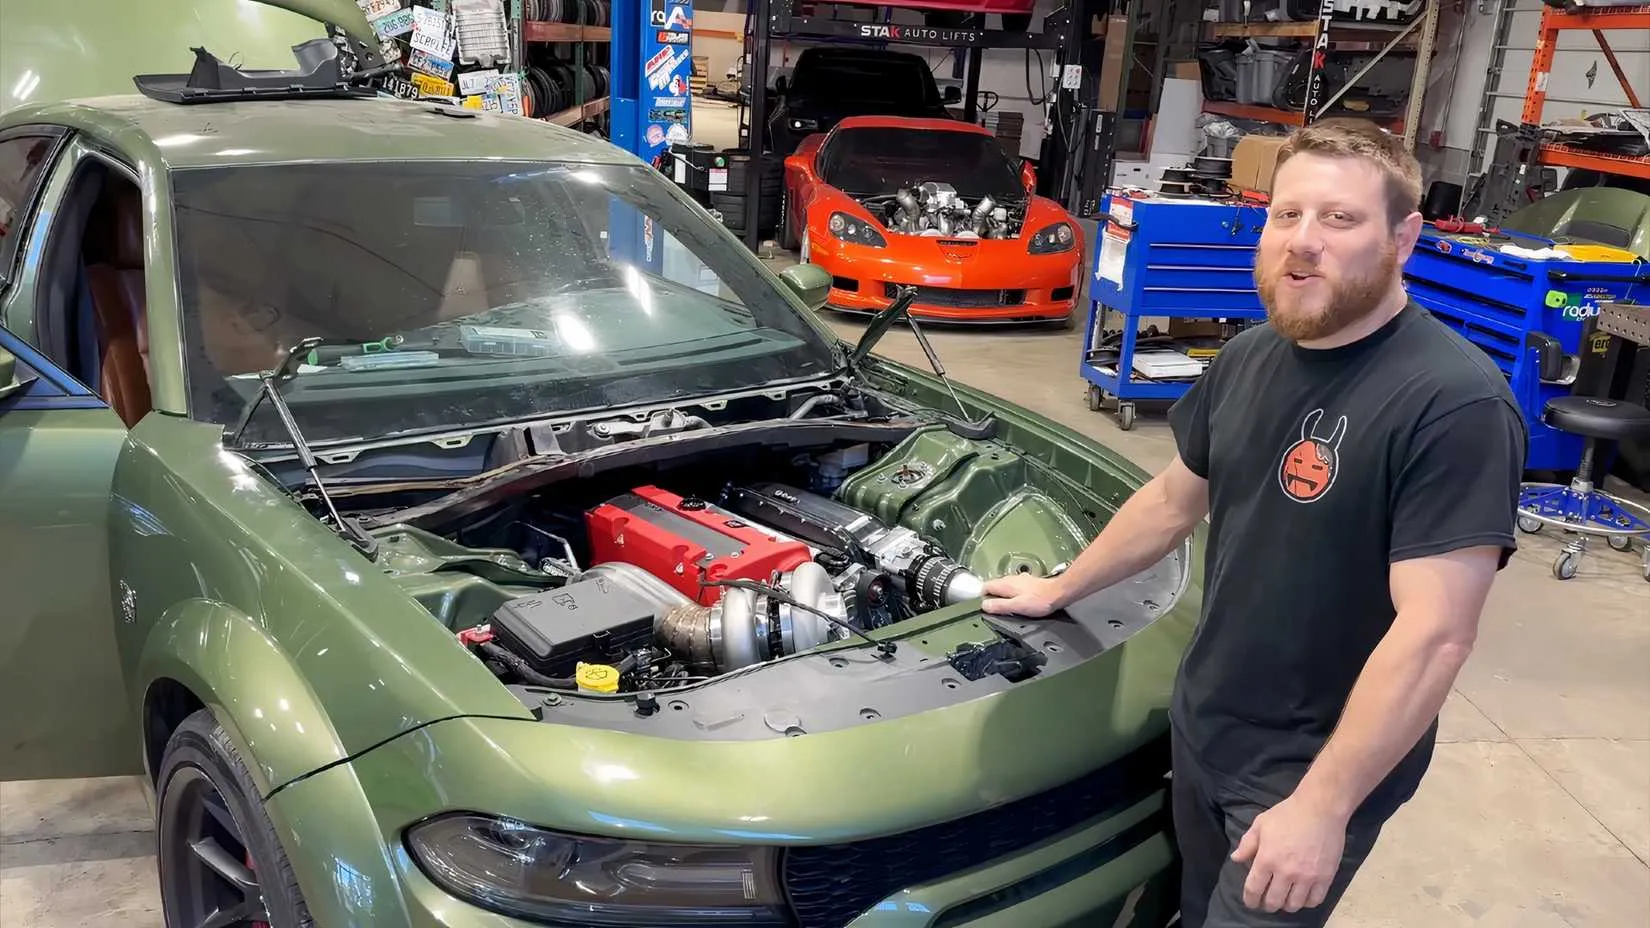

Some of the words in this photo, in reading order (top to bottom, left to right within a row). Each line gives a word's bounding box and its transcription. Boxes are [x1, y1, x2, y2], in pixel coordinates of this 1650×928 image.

[861, 25, 900, 38] STAK
[904, 28, 938, 39] AUTO
[942, 31, 976, 42] LIFTS
[1562, 302, 1601, 318] radiu
